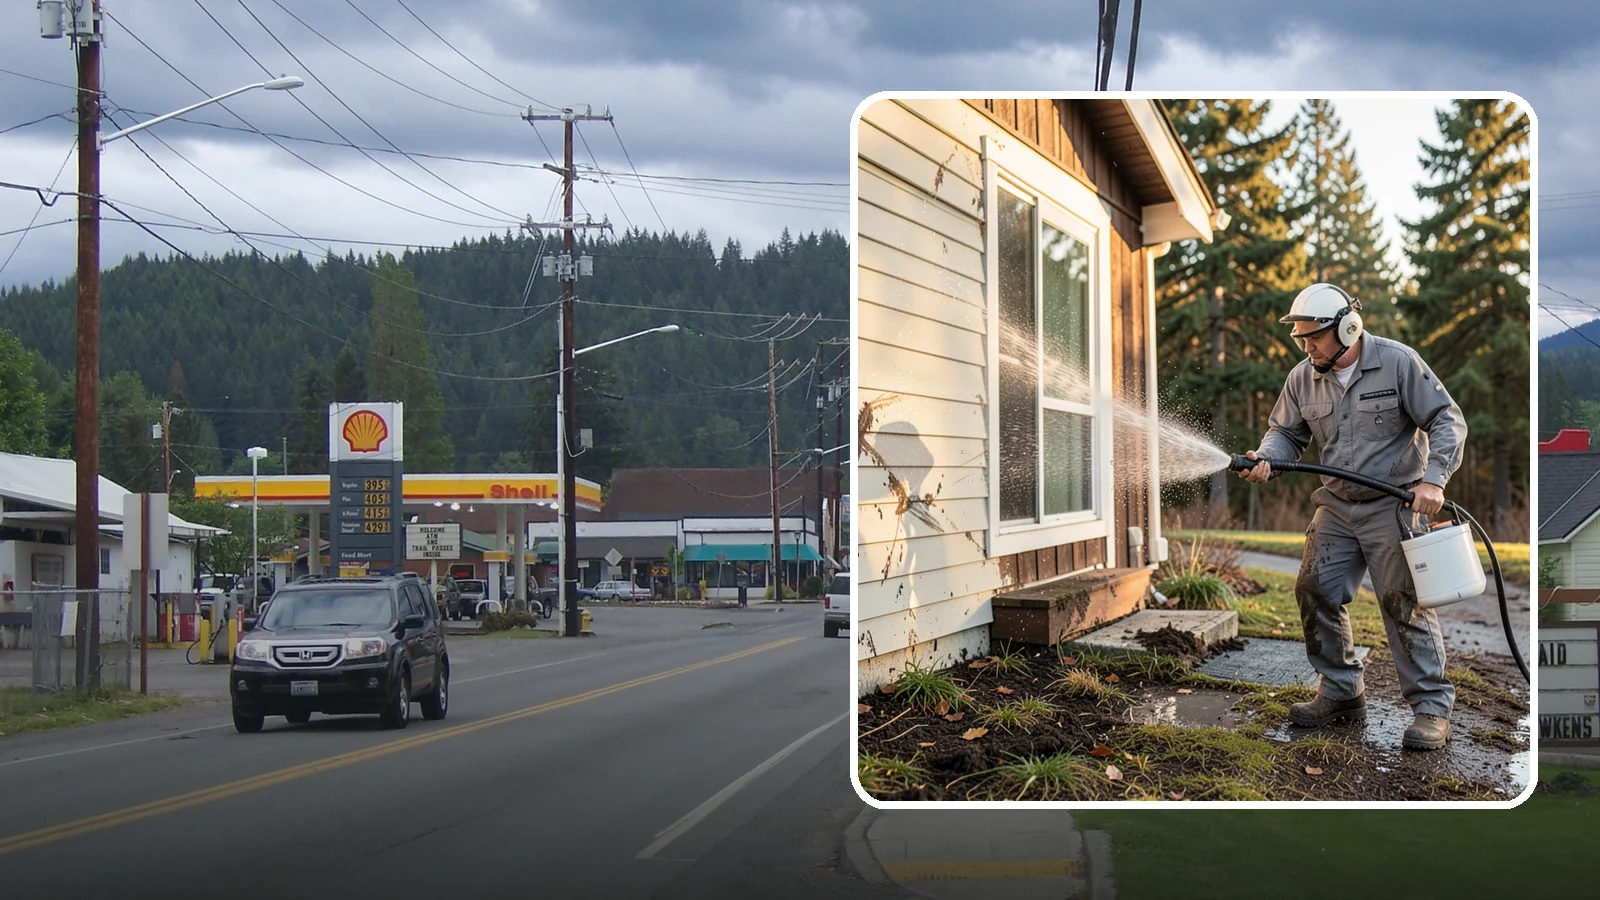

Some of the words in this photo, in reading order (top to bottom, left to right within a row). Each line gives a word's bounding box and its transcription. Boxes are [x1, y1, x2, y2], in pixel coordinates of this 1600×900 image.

[366, 480, 384, 490] 395
[490, 484, 547, 499] Shell
[366, 494, 384, 504] 405
[366, 508, 384, 518] 415
[366, 522, 384, 533] 429
